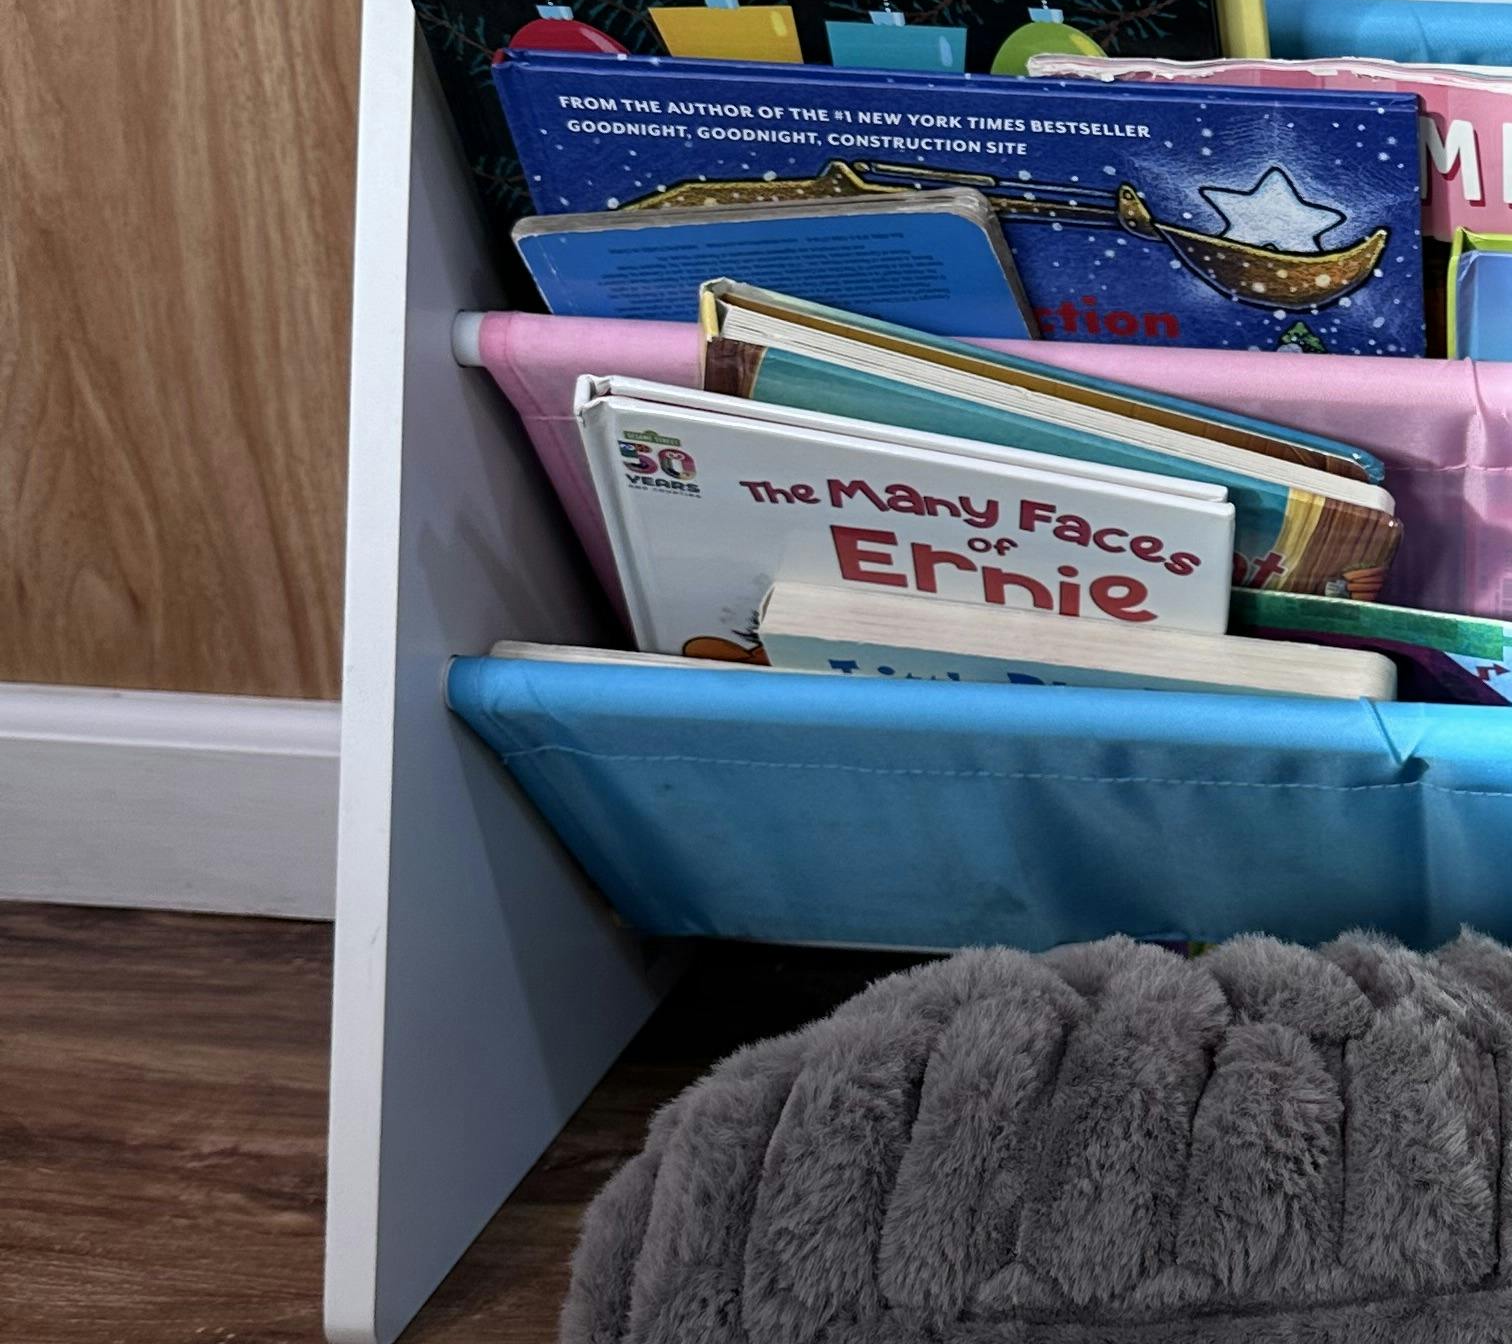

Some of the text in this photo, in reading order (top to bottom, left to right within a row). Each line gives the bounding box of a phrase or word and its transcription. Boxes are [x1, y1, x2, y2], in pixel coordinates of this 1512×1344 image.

[558, 95, 1151, 139] FROM THE AUTHOR OF THE #1 NEW YORK TIMES BESTSELLER
[567, 119, 1028, 156] GOODNIGHT, GOODNIGHT, CONSTRUCTION SITE
[1420, 116, 1487, 207] M
[1033, 295, 1181, 338] ction
[618, 440, 697, 481] 50
[625, 473, 700, 493] YEARS
[738, 479, 821, 506] The
[825, 478, 1000, 530] Many
[1018, 499, 1203, 577] Faces
[829, 523, 1159, 623] Ernie
